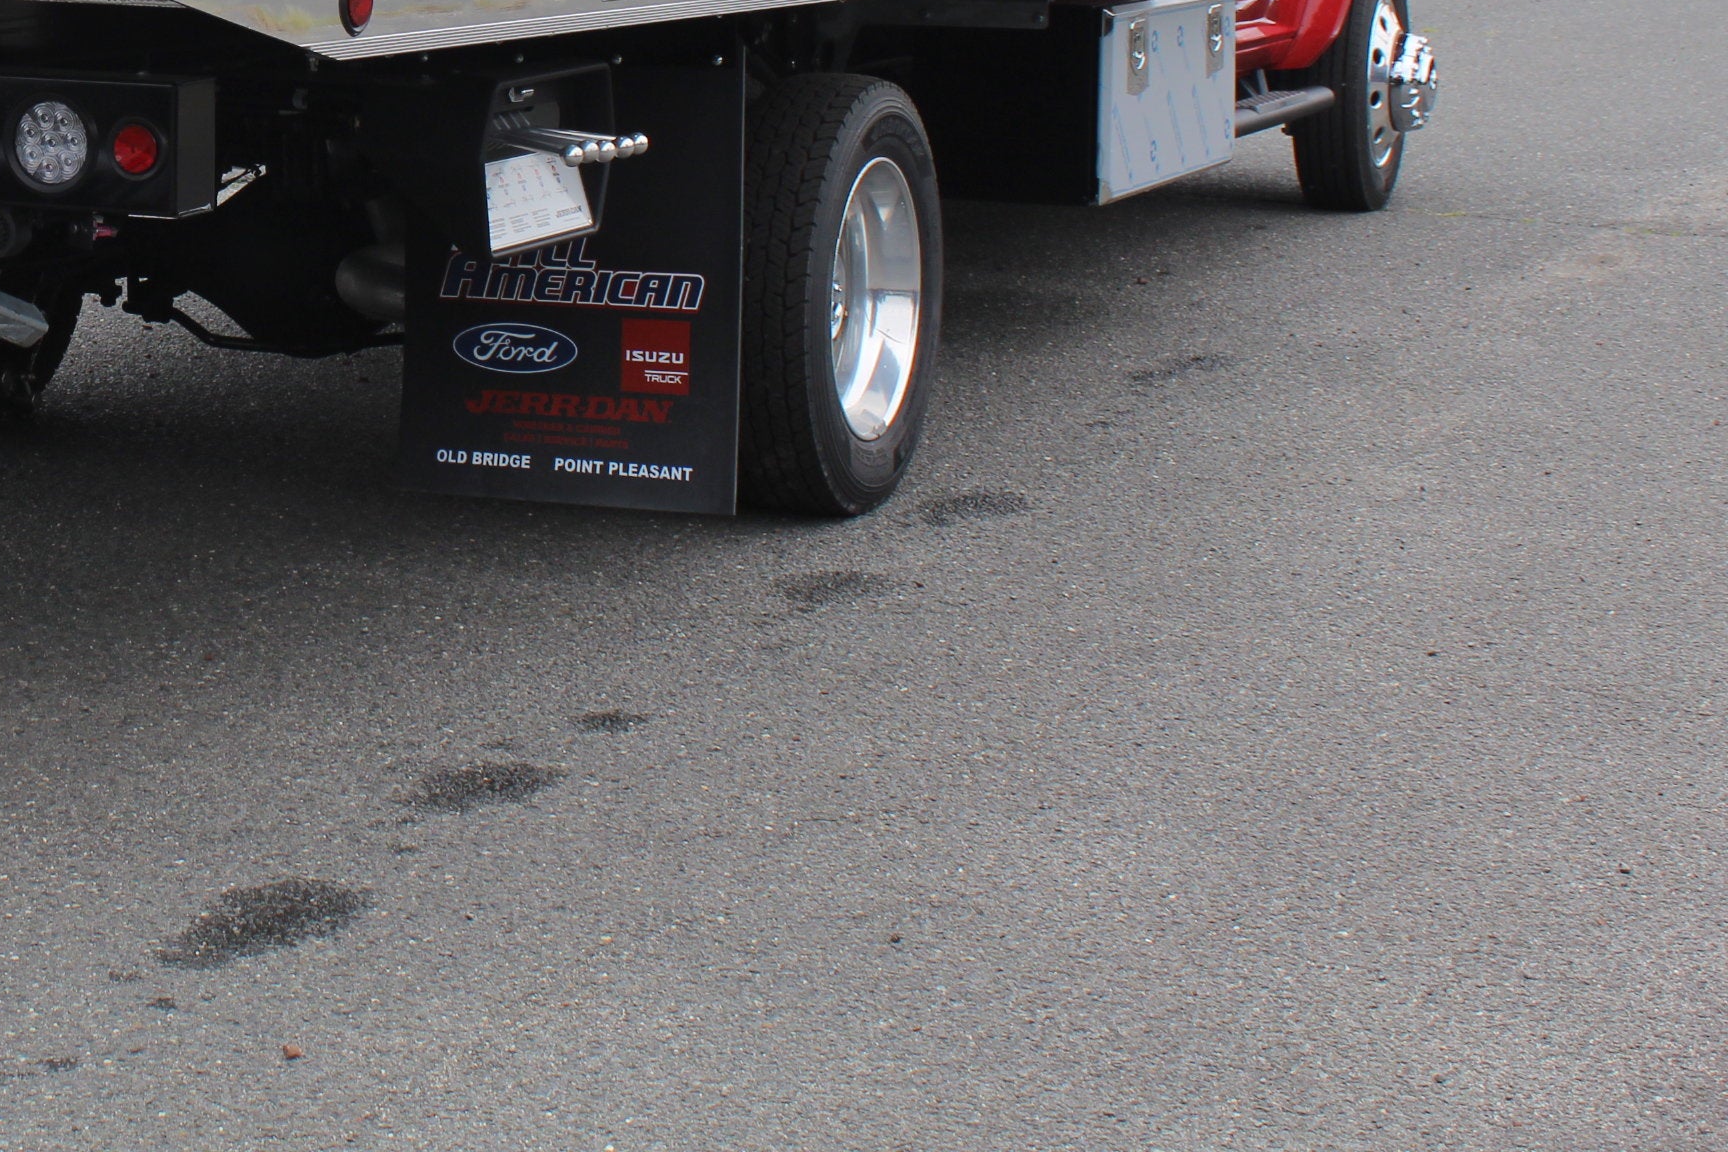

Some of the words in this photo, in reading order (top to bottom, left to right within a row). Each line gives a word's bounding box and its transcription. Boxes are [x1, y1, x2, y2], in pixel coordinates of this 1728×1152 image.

[440, 251, 705, 311] AMERICAN
[473, 330, 558, 363] Ford
[625, 350, 684, 364] ISUZU
[644, 374, 682, 384] TRUCK
[437, 449, 467, 464] OLD
[472, 451, 531, 469] BRIDGE
[554, 457, 604, 475] POINT
[608, 461, 693, 482] PLEASANT
